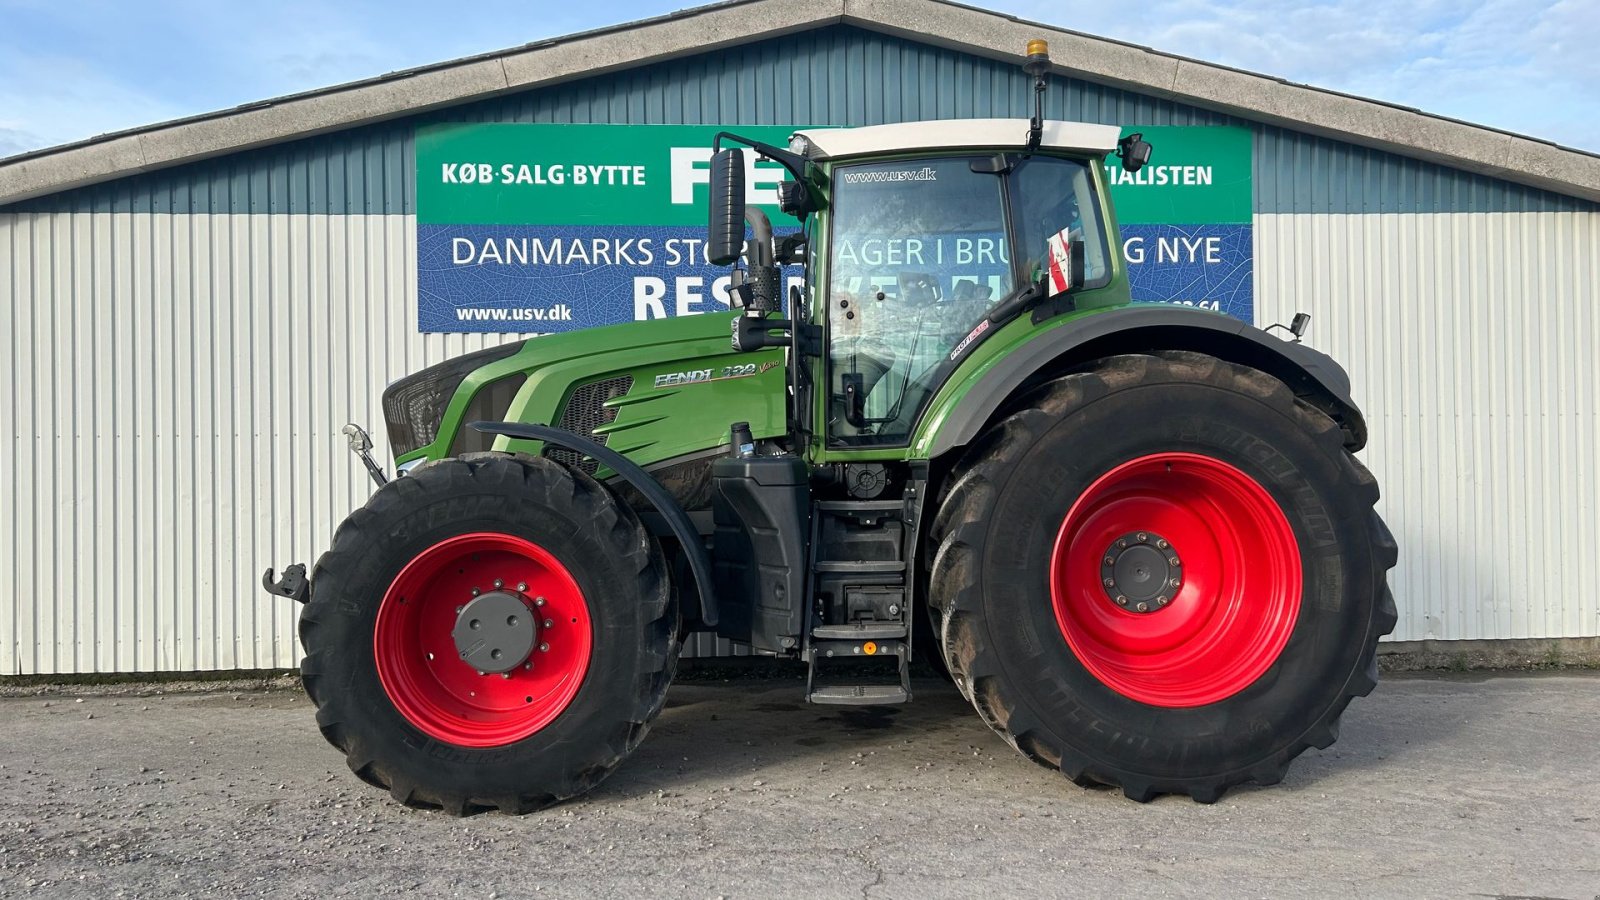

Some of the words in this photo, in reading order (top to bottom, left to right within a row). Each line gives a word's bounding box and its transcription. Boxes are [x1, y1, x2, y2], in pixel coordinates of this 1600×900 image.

[845, 167, 936, 184] www.usv.dk
[1104, 165, 1212, 186] IALISTEN
[453, 237, 653, 265] DANMARKS
[837, 238, 924, 266] AGER
[937, 238, 943, 265] I
[956, 238, 1010, 265] BRU
[1123, 237, 1145, 263] G
[1158, 237, 1221, 263] NYE
[456, 303, 572, 321] www.usv.dk
[655, 369, 715, 386] FENDT
